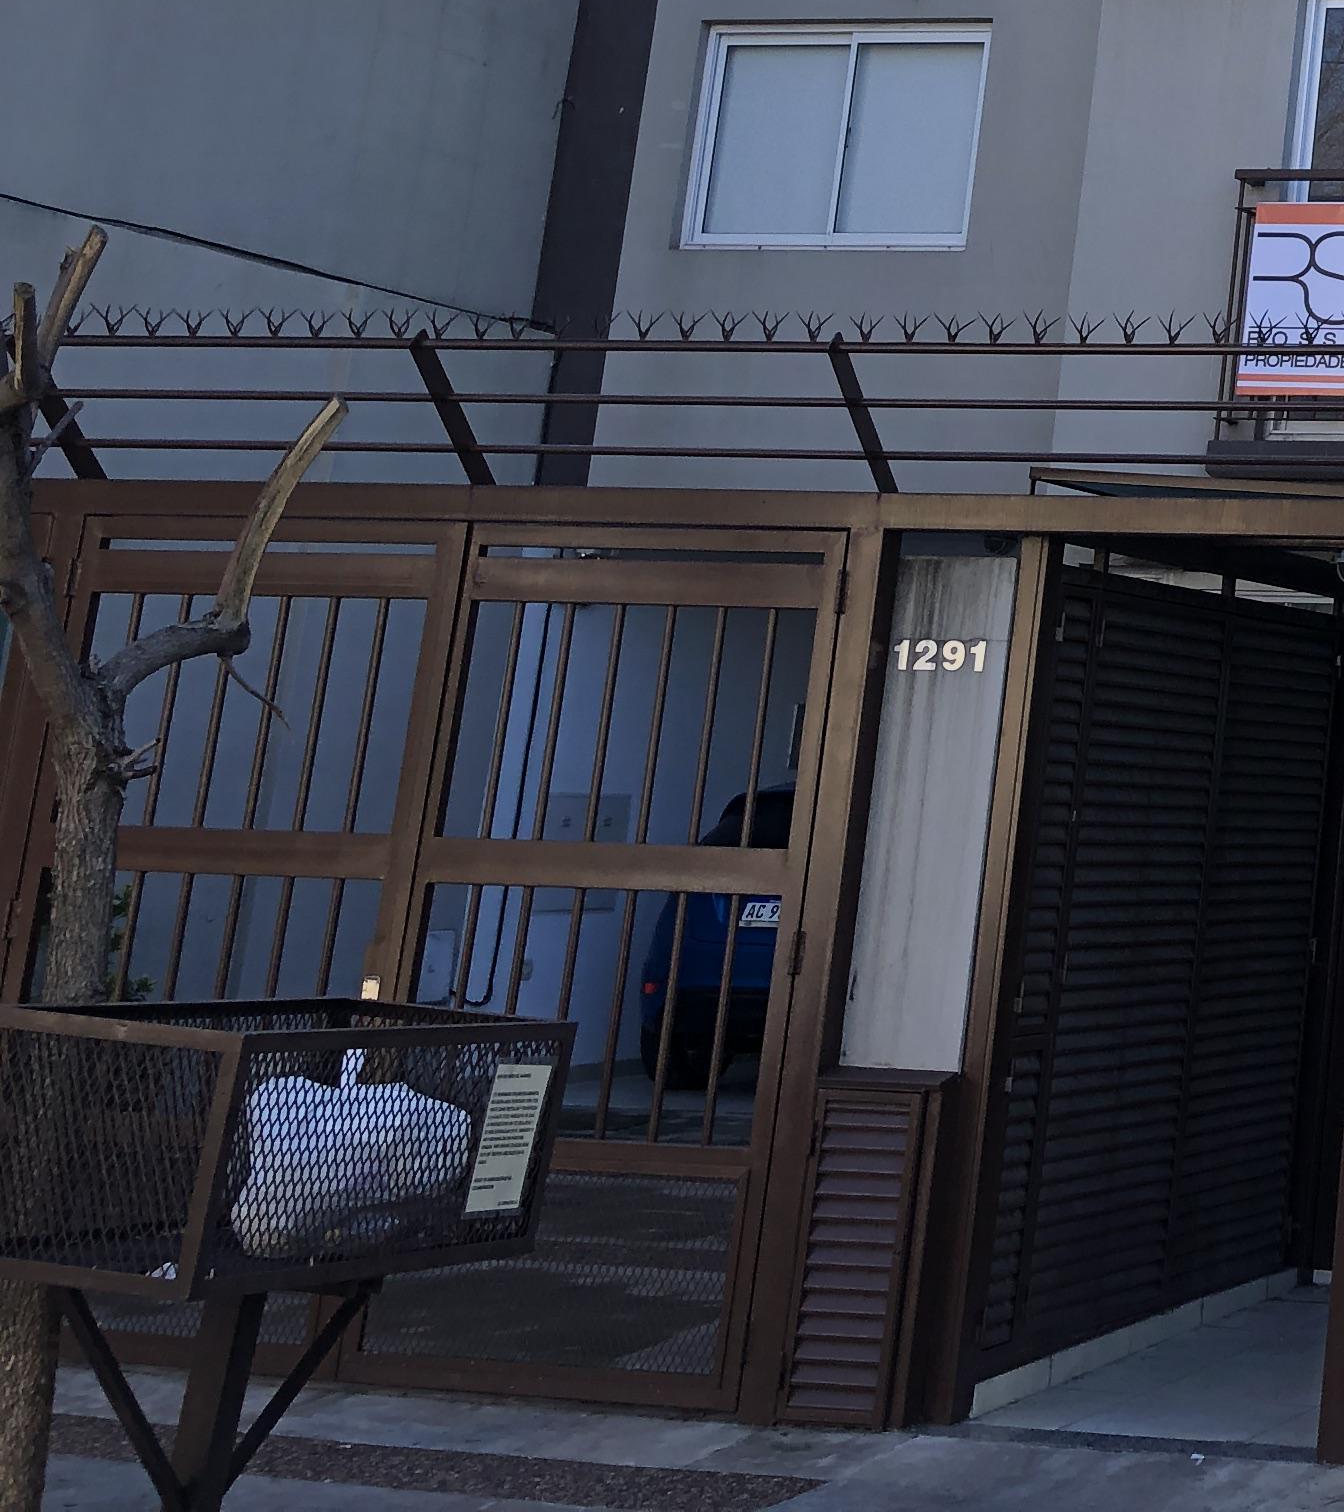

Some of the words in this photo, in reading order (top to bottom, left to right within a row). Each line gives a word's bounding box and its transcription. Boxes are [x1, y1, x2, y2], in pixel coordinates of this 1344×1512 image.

[894, 639, 987, 672] 1291
[745, 904, 767, 919] AC
[769, 904, 780, 919] 9
